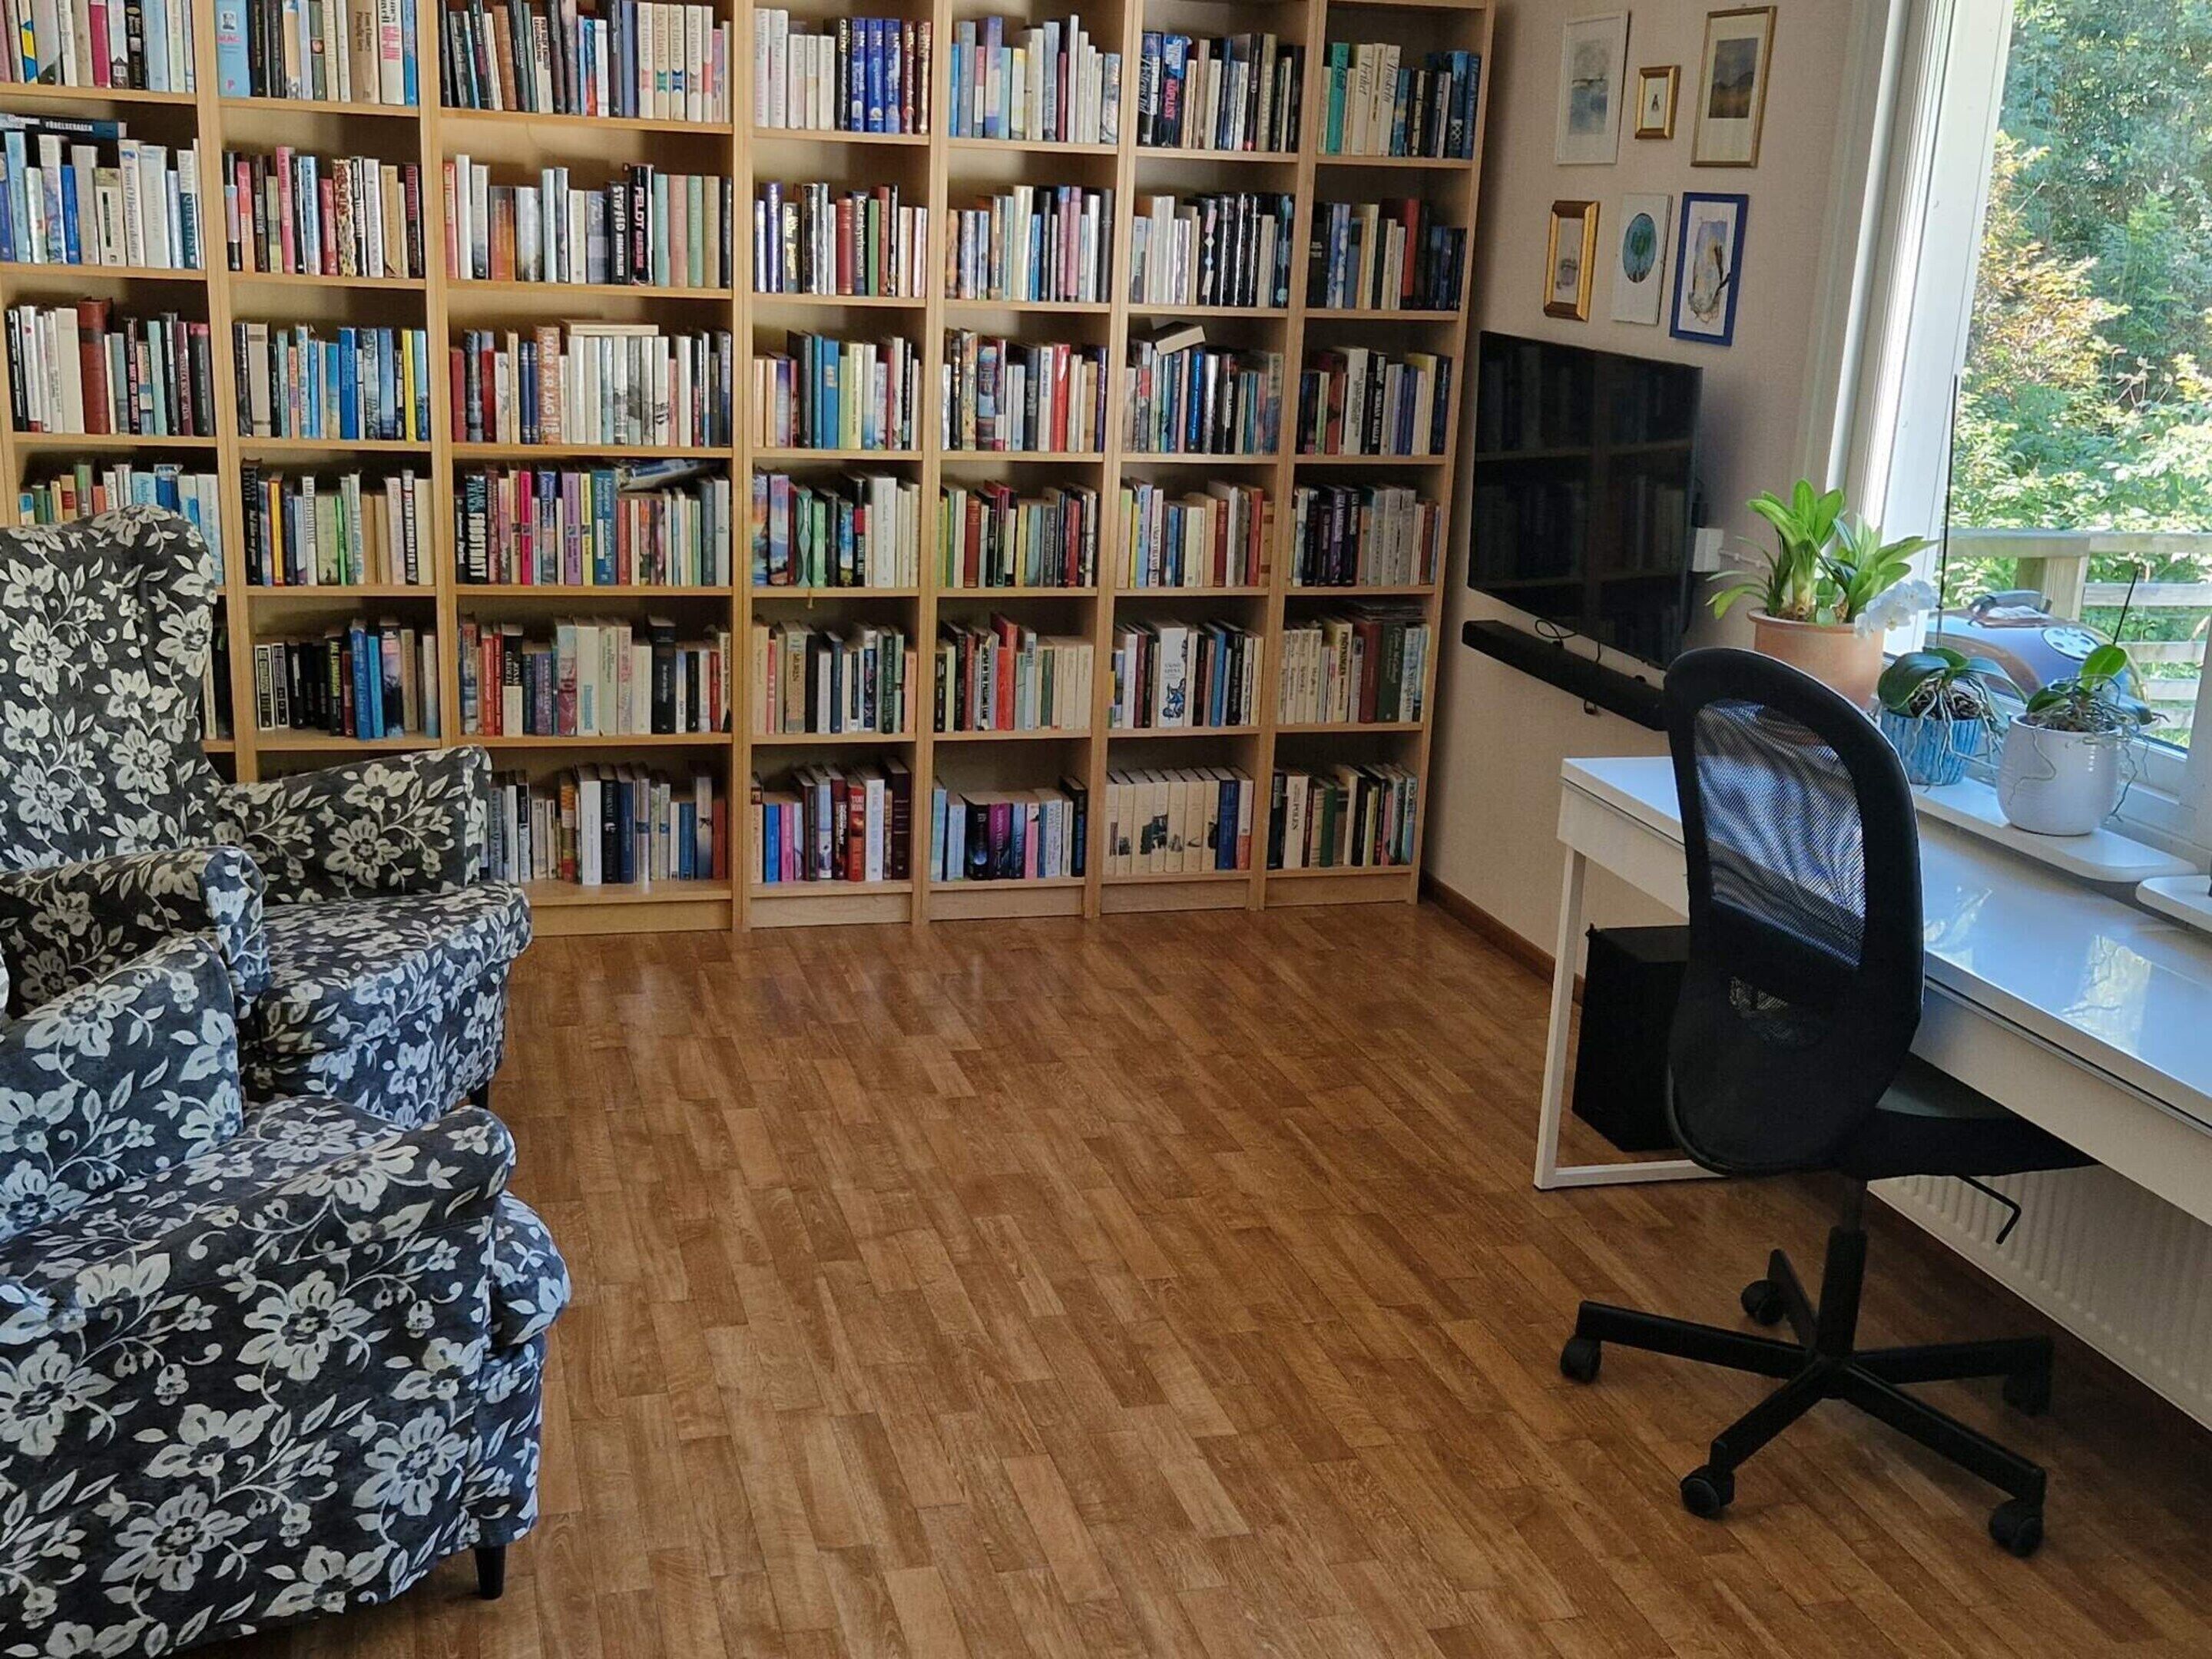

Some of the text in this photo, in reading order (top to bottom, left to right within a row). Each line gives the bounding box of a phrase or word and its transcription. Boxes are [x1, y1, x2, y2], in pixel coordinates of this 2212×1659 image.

[184, 194, 197, 253] QUENTINS
[612, 185, 626, 232] STIFFED
[634, 186, 645, 230] FELDT
[544, 392, 555, 416] JAG
[468, 512, 487, 578] FROSTNATT
